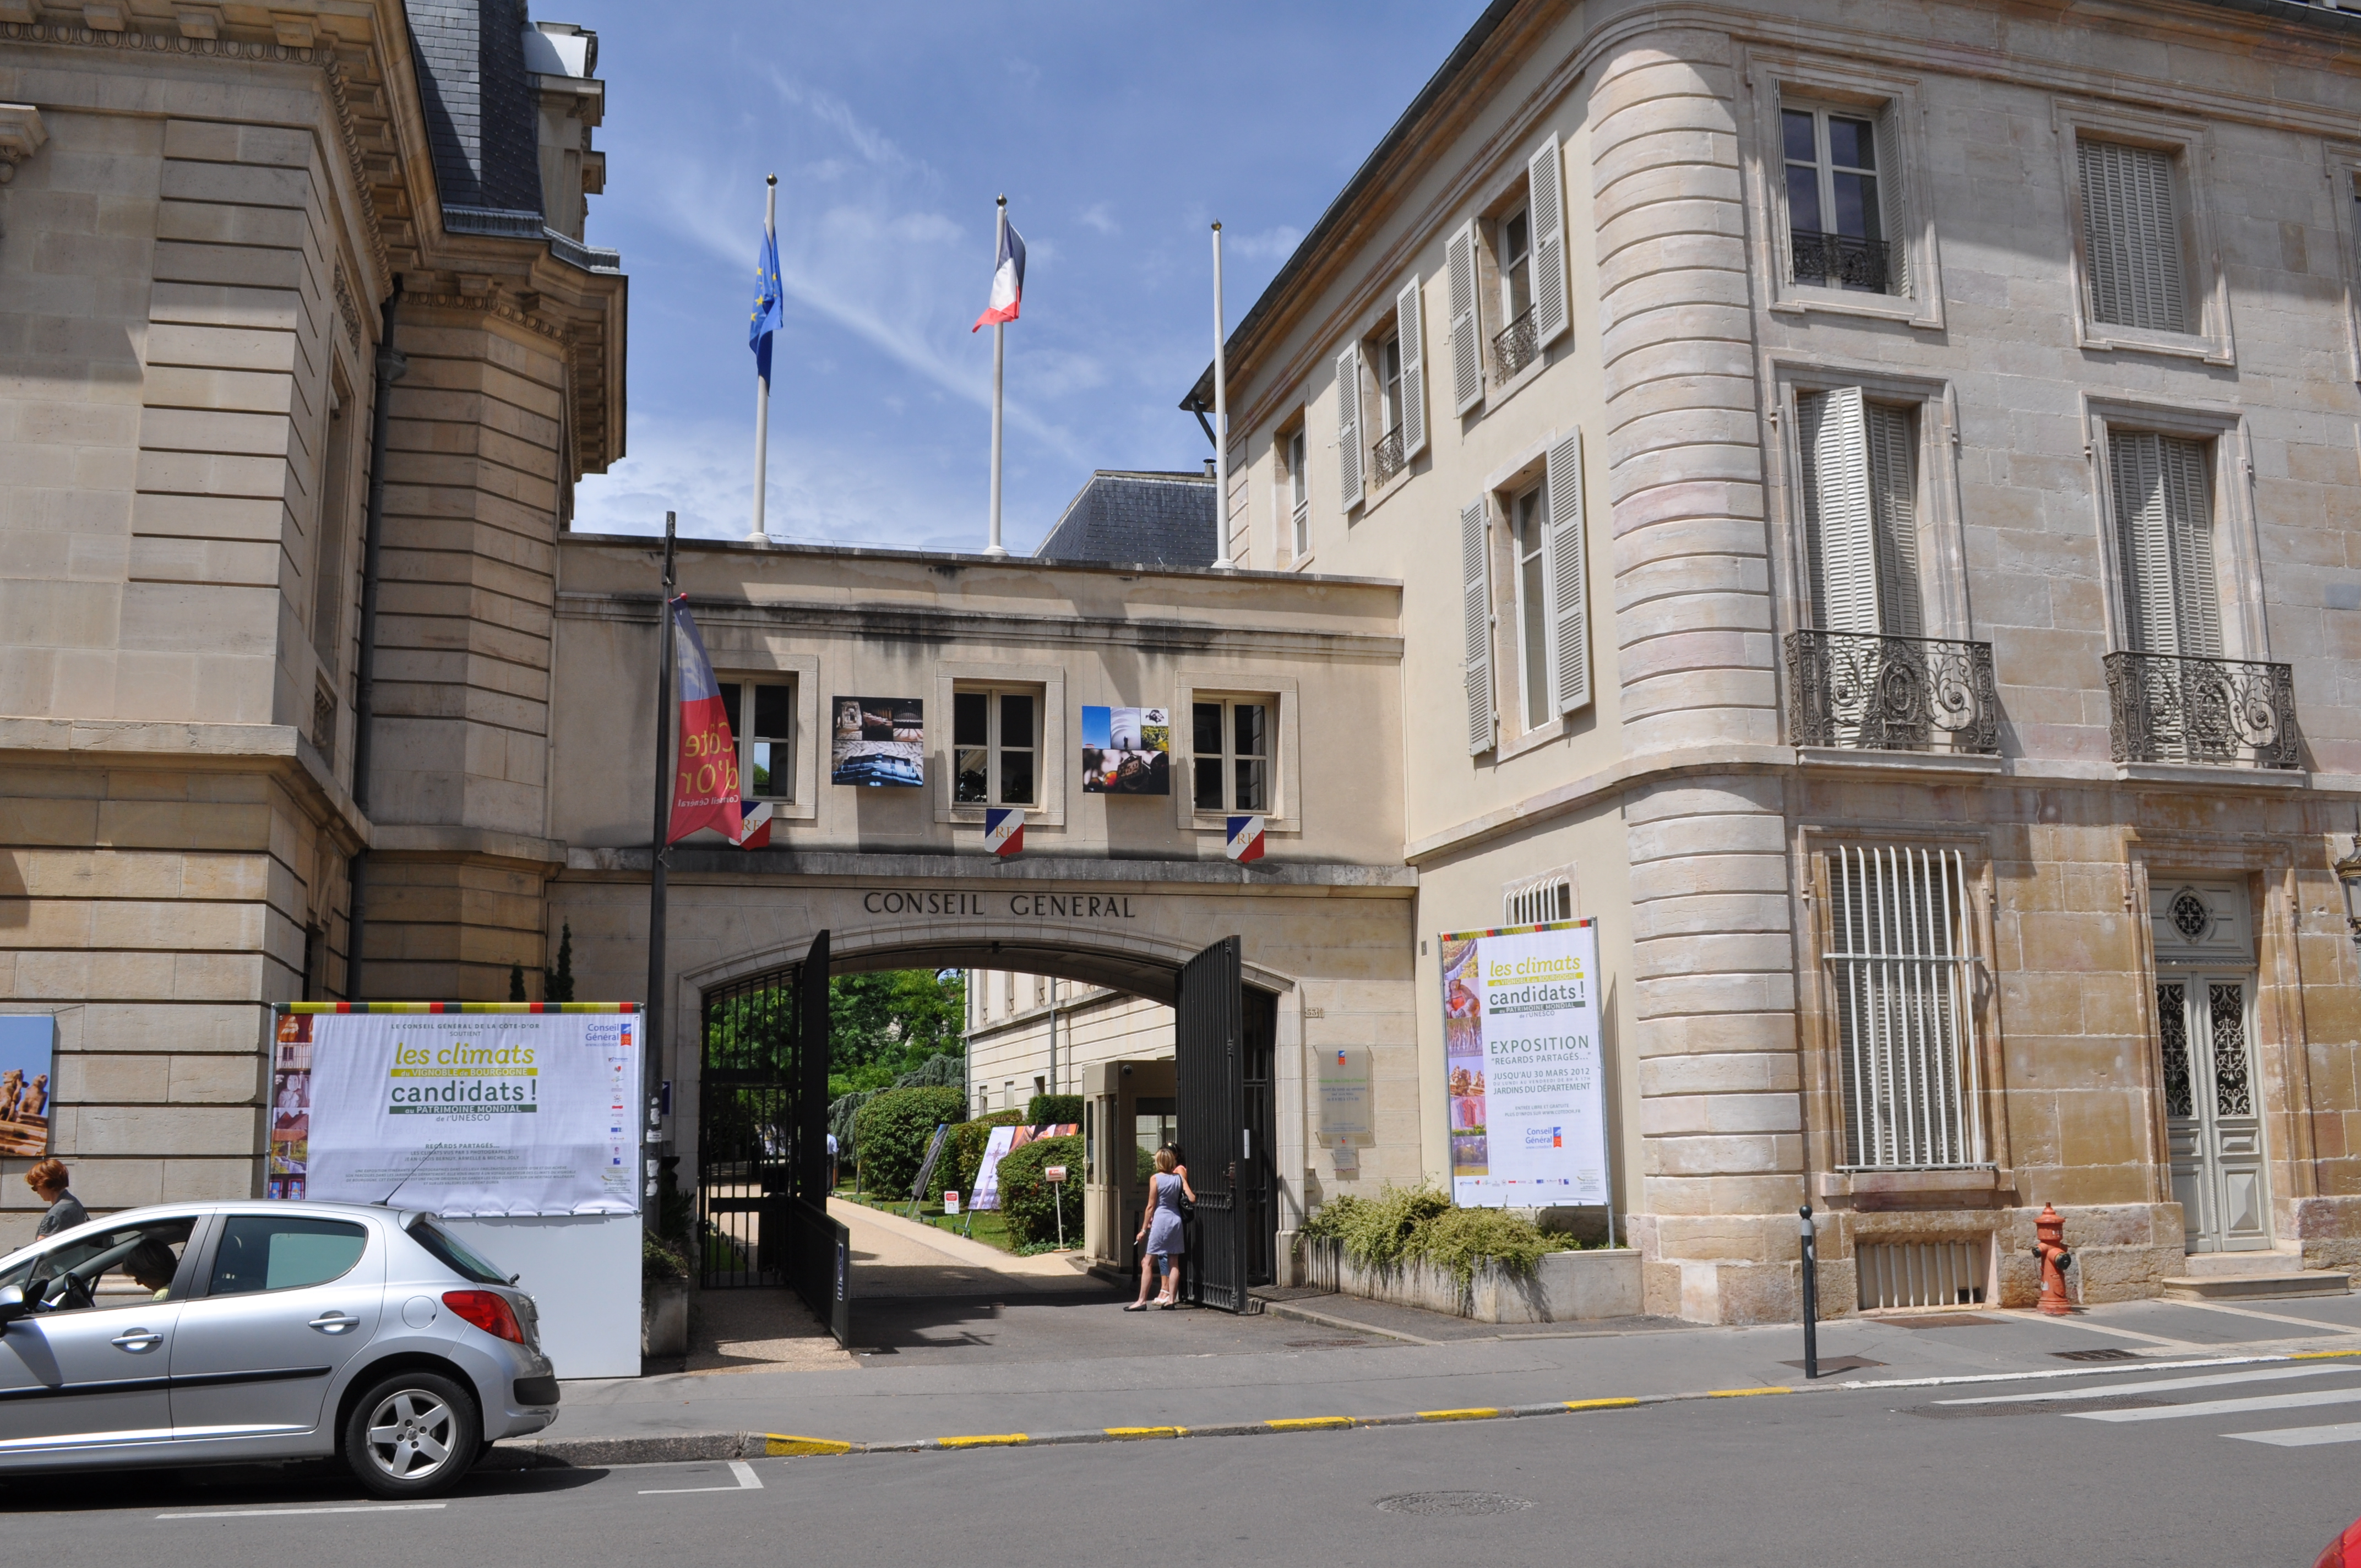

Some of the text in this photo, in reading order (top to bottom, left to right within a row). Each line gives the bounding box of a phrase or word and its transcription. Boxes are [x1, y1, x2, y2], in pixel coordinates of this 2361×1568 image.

[742, 819, 761, 831] RF
[995, 826, 1014, 838] RF
[1236, 832, 1255, 844] RF
[864, 892, 1135, 918] CONSEIL GENERAL
[1490, 955, 1580, 977] les climats
[1490, 984, 1576, 1005] candidats
[1490, 1035, 1588, 1054] EXPOSITION
[396, 1042, 535, 1065] les climats
[1494, 1071, 1531, 1080] JUSQU'AU
[391, 1080, 524, 1102] candidats
[1494, 1086, 1523, 1095] JARDINS
[1537, 1082, 1591, 1092] DÉPARTEMENT
[1527, 1127, 1552, 1135] Conseil
[1526, 1135, 1552, 1144] Général
